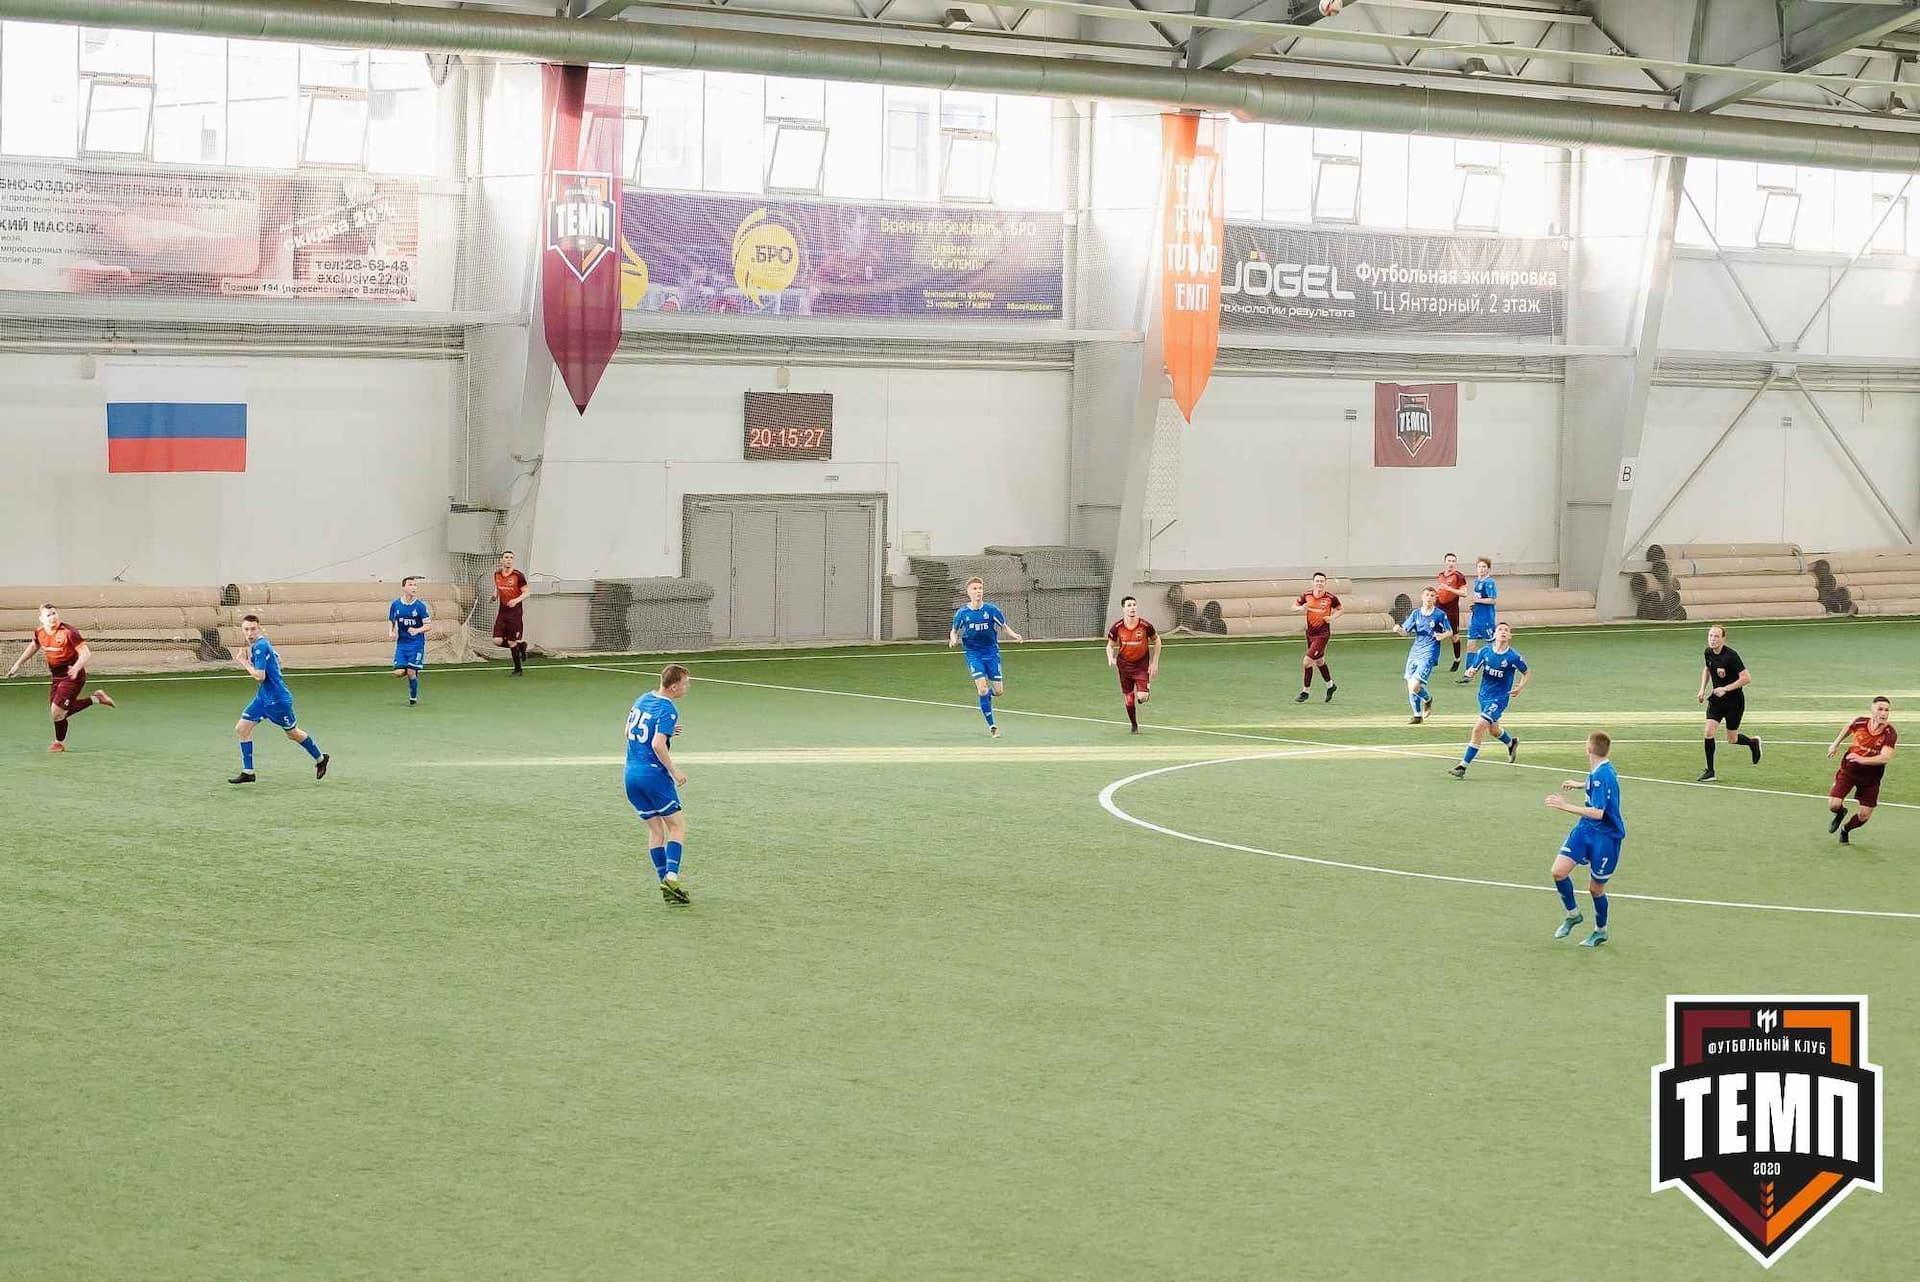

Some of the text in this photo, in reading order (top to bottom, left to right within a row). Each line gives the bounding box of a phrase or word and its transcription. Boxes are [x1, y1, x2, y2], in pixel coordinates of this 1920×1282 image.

[555, 202, 610, 241] ТЕМП
[1355, 262, 1558, 290] Футбольная экипировка
[1288, 307, 1356, 319] результата
[1373, 291, 1541, 316] ТЦ Янтарный, 2 этаж
[1399, 411, 1429, 433] ТЕМП
[750, 427, 825, 448] 20:15:27
[1488, 667, 1504, 679] ВТБ
[627, 706, 653, 744] 25
[1601, 857, 1609, 869] 7
